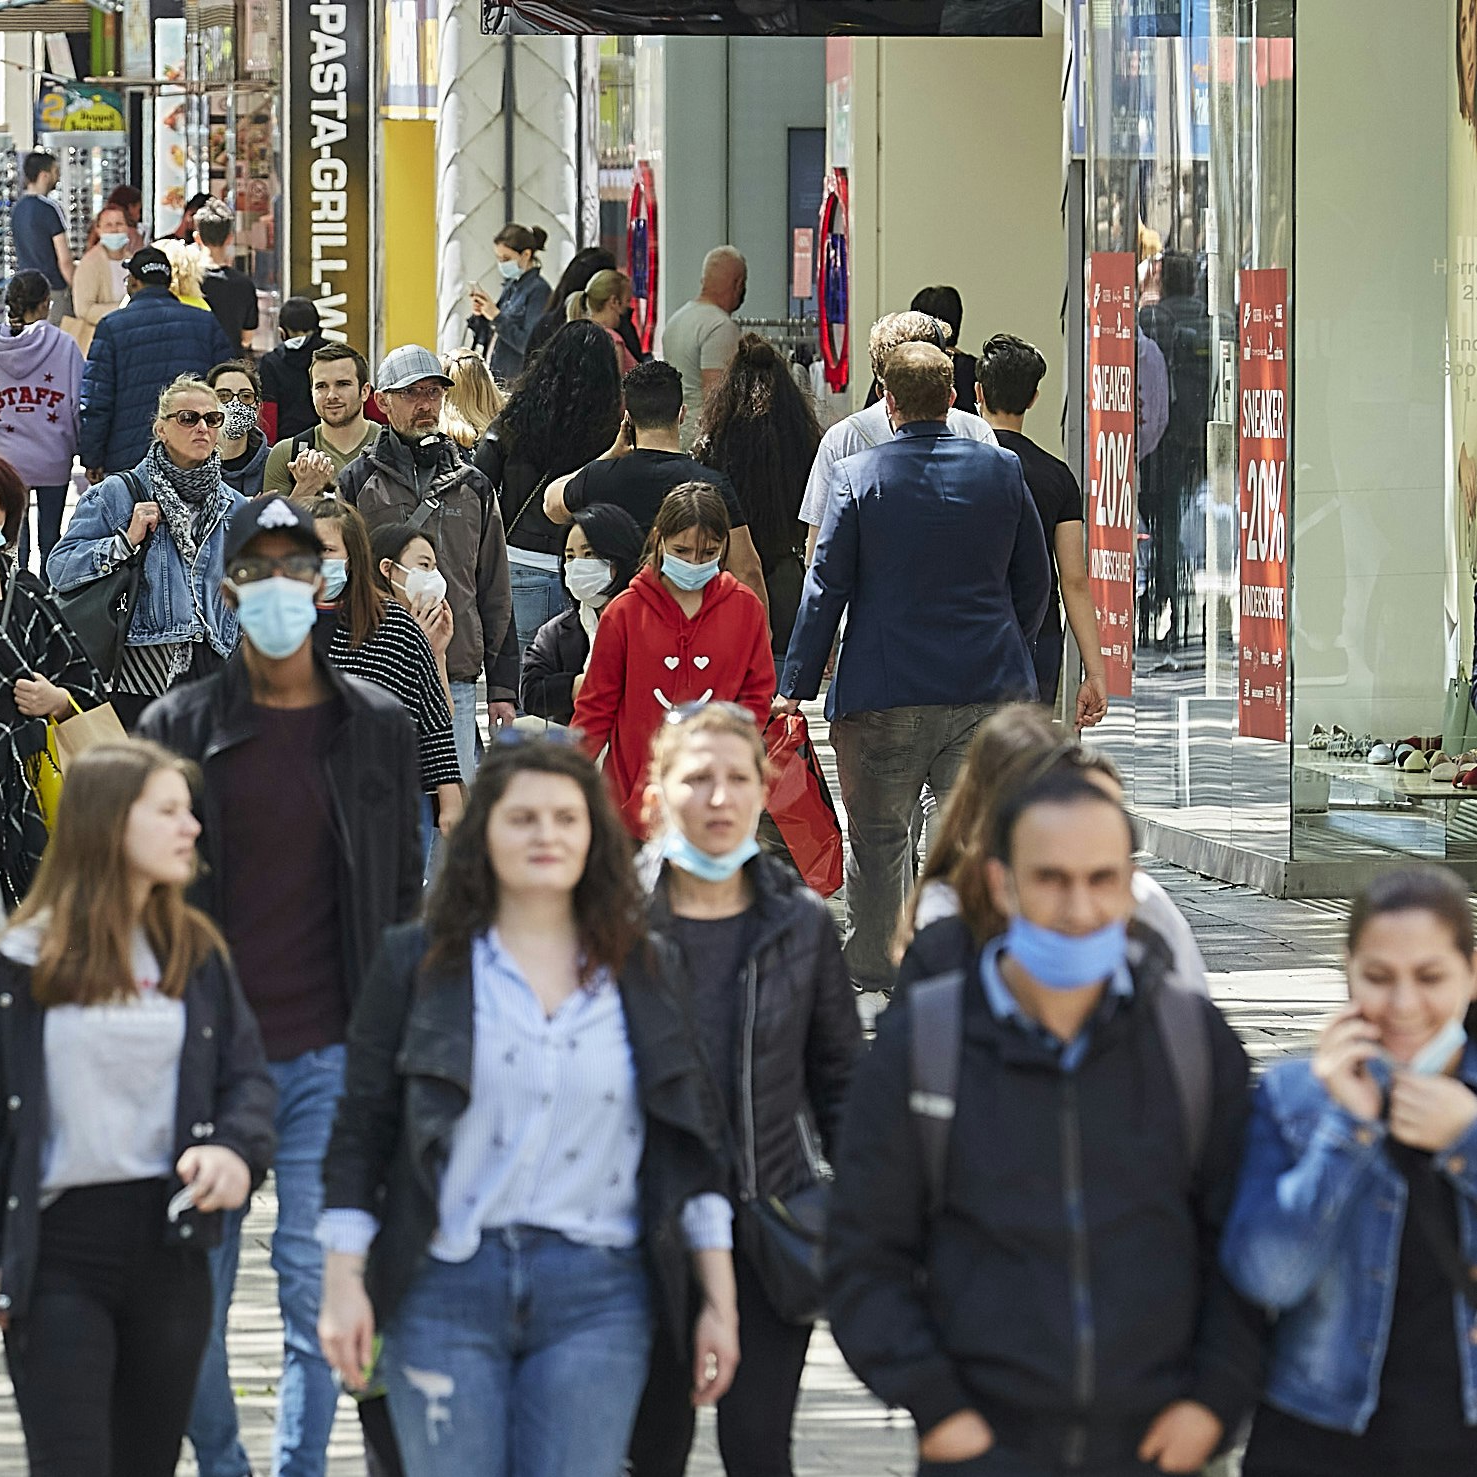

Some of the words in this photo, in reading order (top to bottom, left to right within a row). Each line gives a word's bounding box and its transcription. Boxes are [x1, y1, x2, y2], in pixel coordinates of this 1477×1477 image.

[310, 0, 348, 344] PASTA-GRILL-W
[1092, 364, 1131, 412] SNEAKER
[1243, 389, 1284, 438] SNEAKER
[1091, 431, 1132, 530] -20%
[1241, 459, 1285, 564] -20%
[1091, 548, 1131, 583] KINDERSCHUHE
[1241, 585, 1284, 620] KINDERSCHUHE
